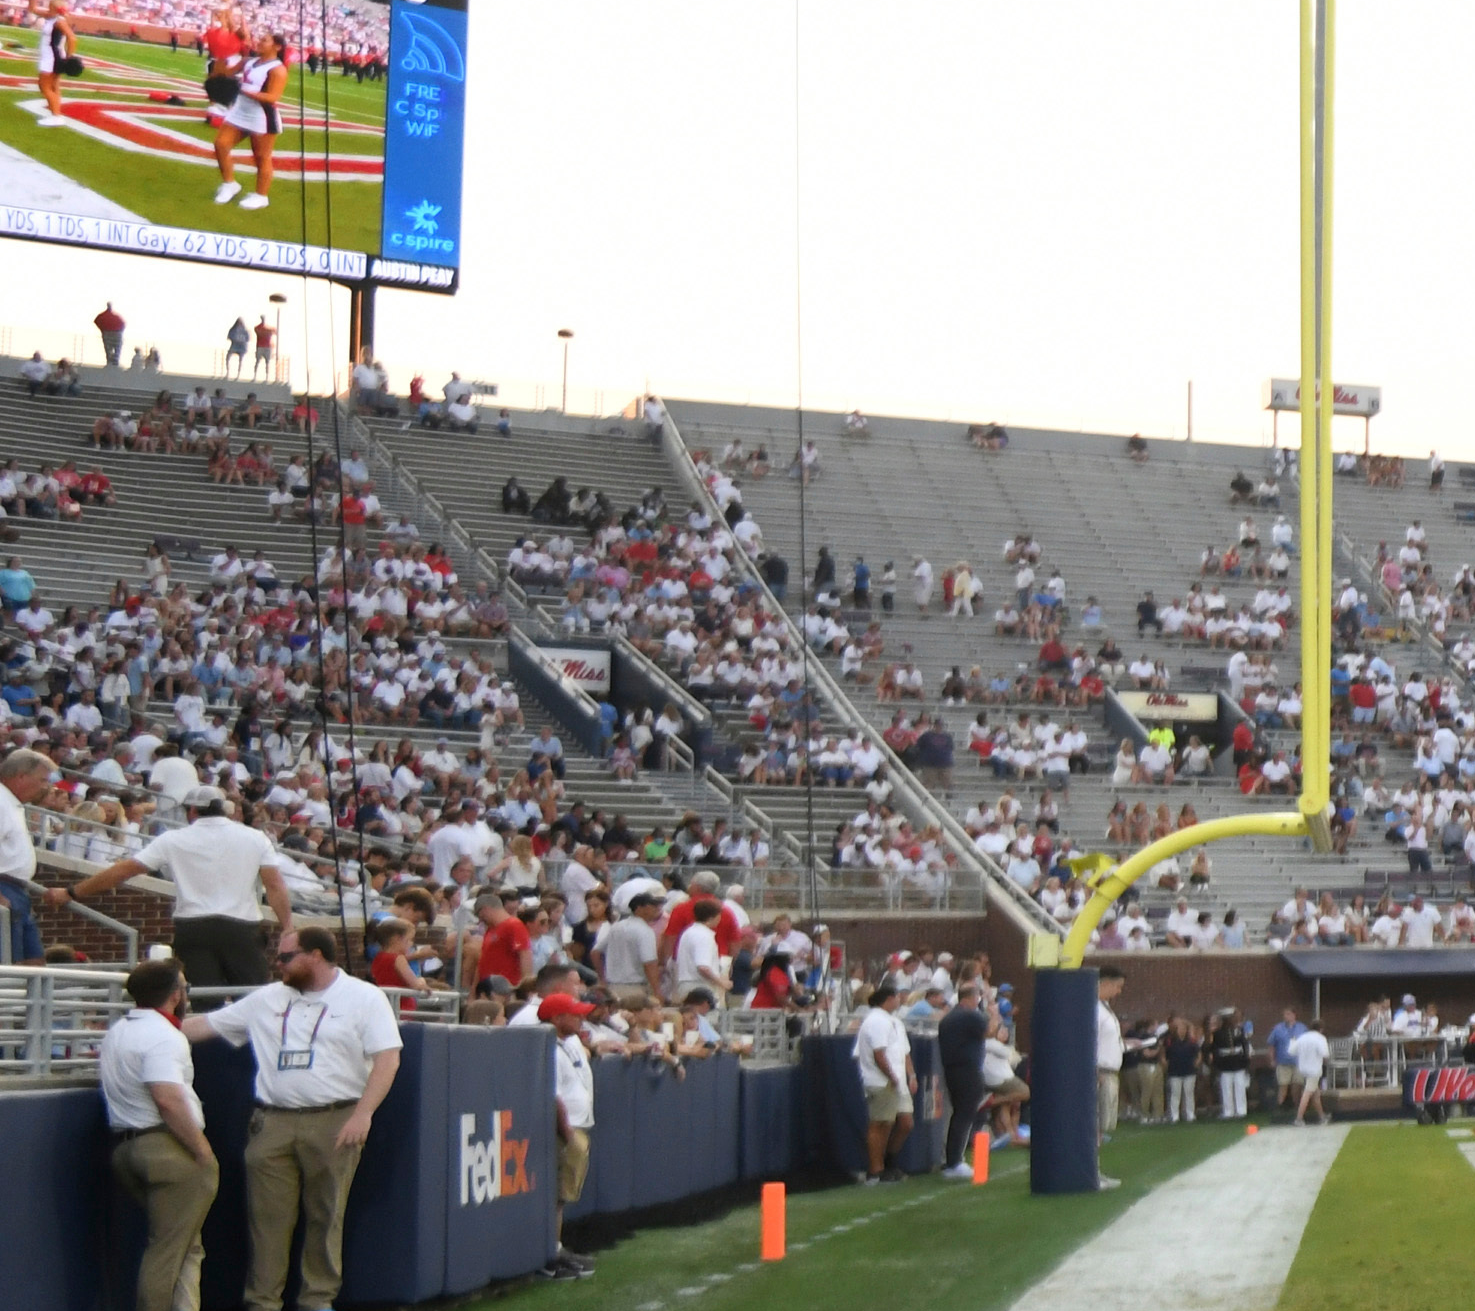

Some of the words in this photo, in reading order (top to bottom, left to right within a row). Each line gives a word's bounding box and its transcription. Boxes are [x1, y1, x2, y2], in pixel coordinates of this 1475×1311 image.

[108, 224, 130, 243] INT
[183, 234, 206, 253] 62
[259, 244, 269, 261] 2
[336, 253, 366, 274] INT
[420, 265, 455, 287] PEAY
[461, 1109, 533, 1206] FedEx
